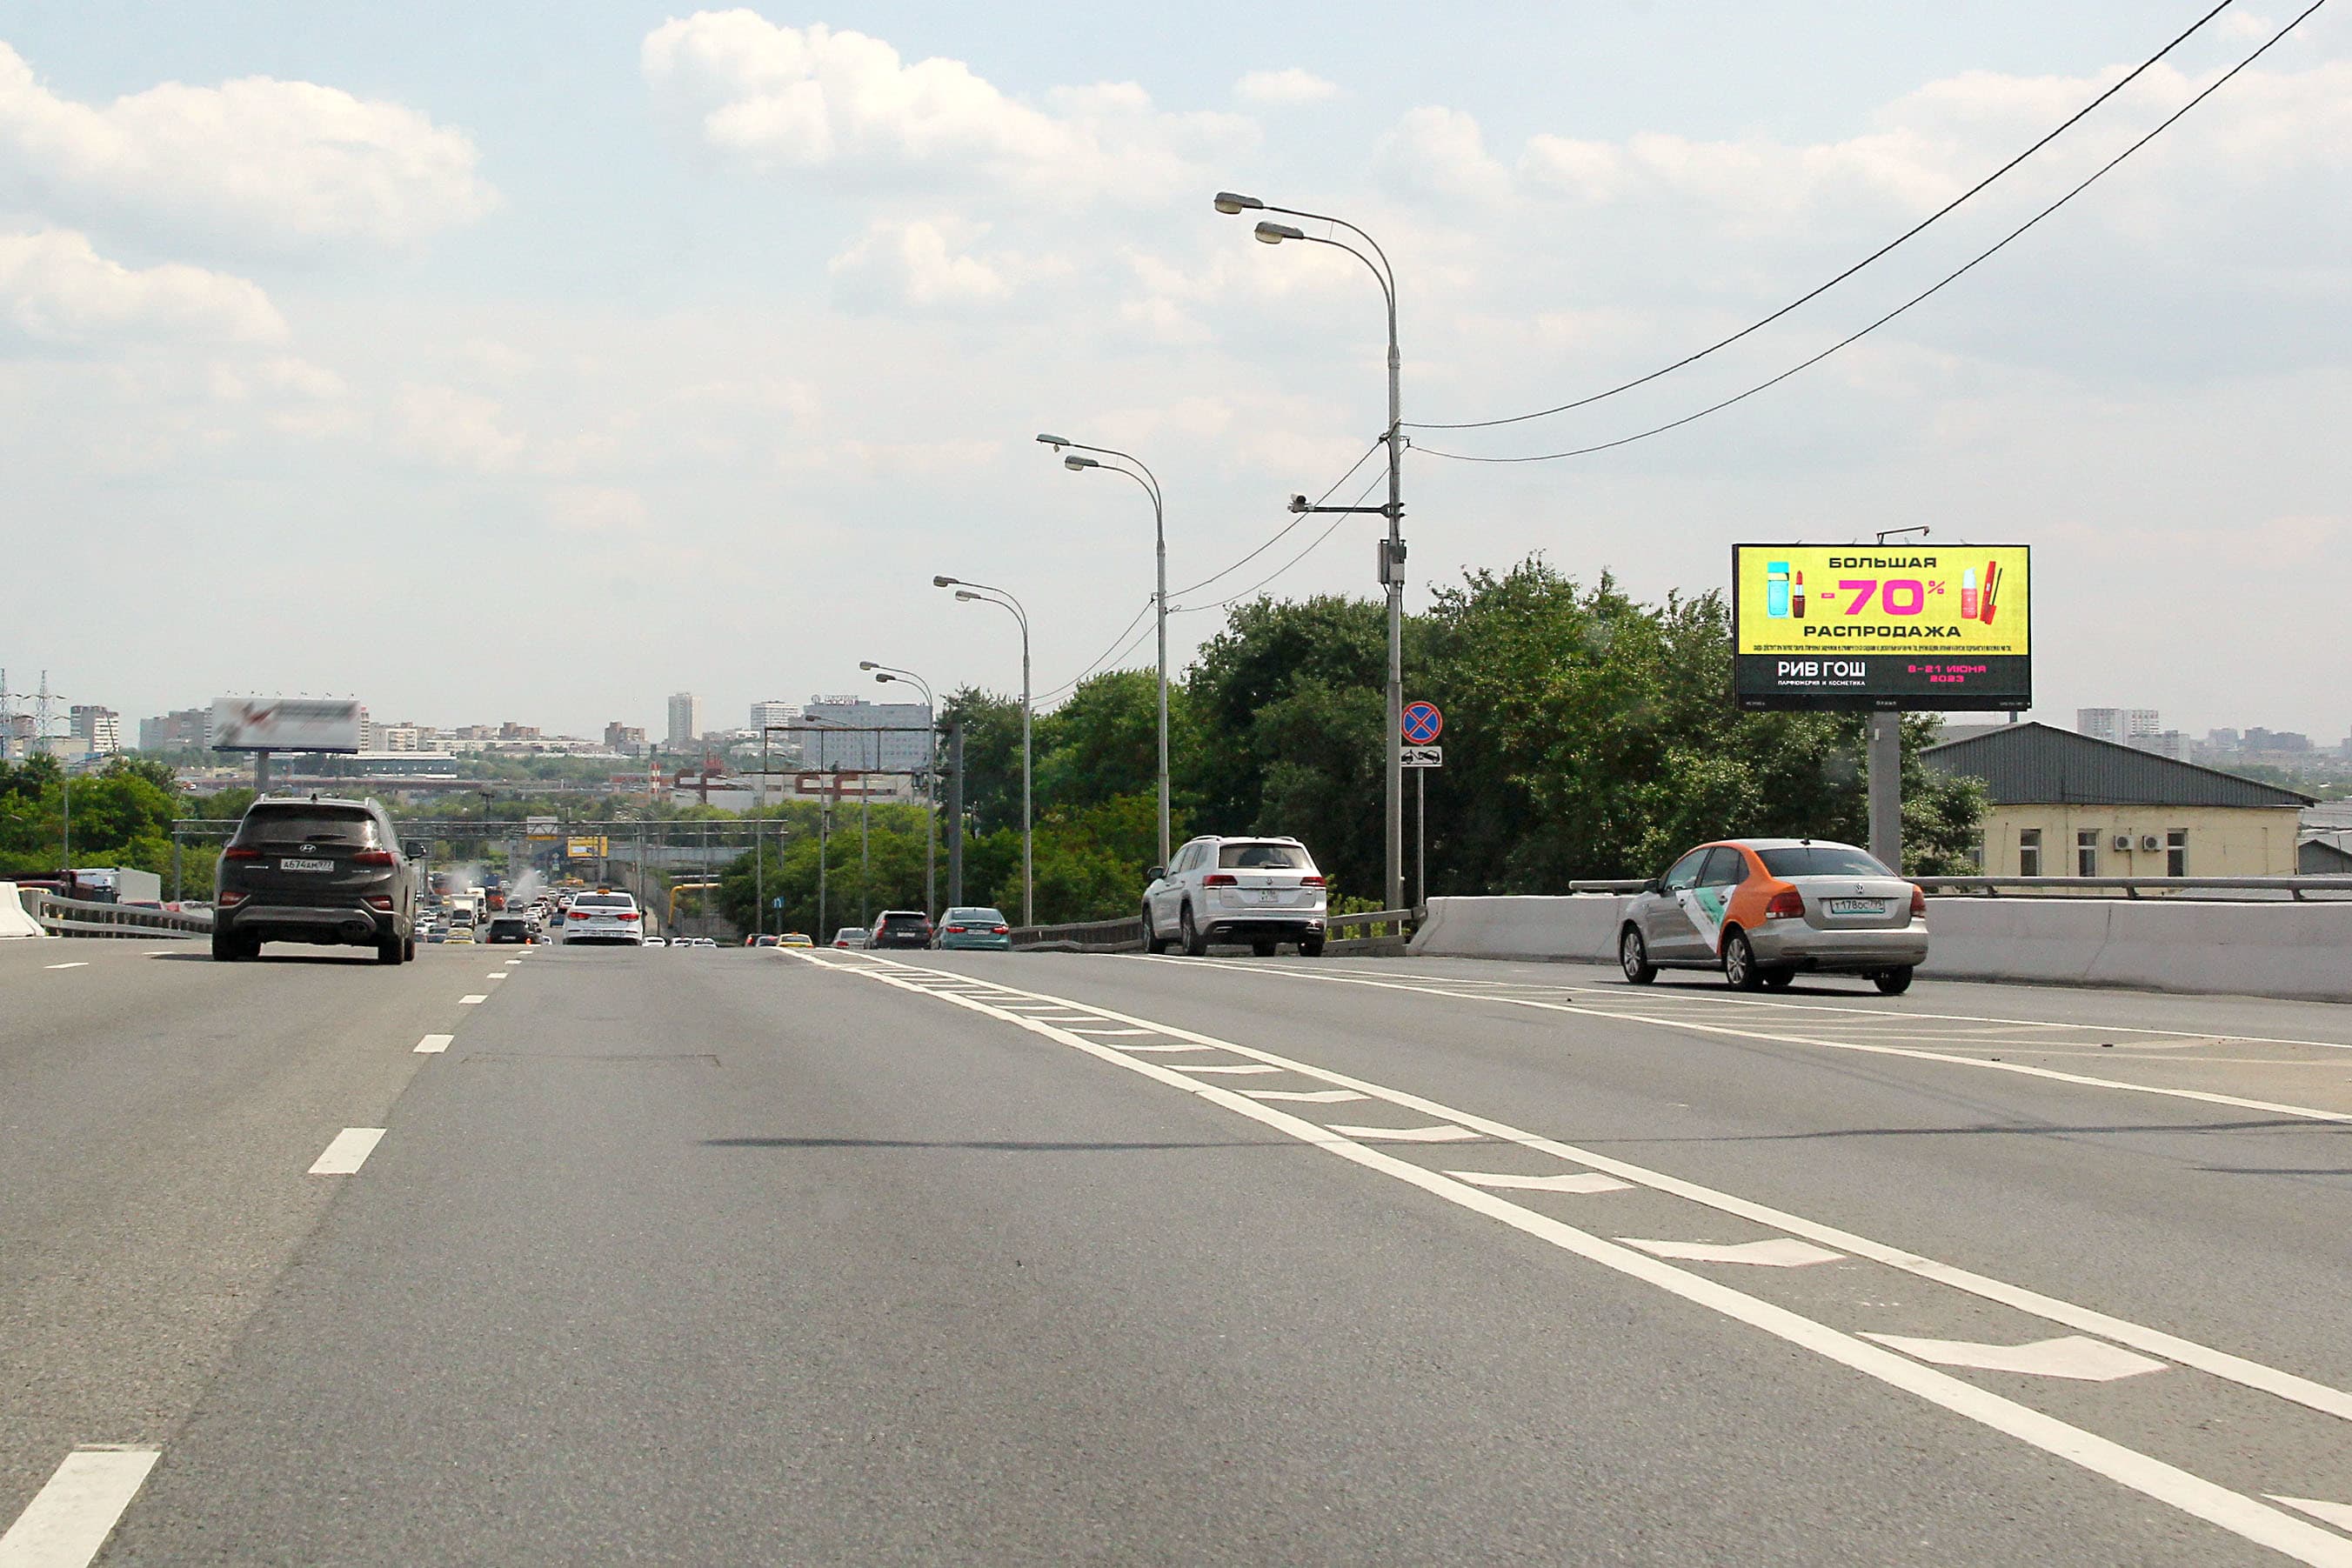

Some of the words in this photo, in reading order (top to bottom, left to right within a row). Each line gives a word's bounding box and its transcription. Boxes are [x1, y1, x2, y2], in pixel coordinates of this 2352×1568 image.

[1829, 557, 1937, 568] БОЛЬШАЯ
[1803, 626, 1961, 638] РАСПРОДАЖА
[1778, 661, 1819, 677] РИВ
[1823, 661, 1866, 677] ГОШ
[1947, 664, 1987, 673] ИЮНЯ
